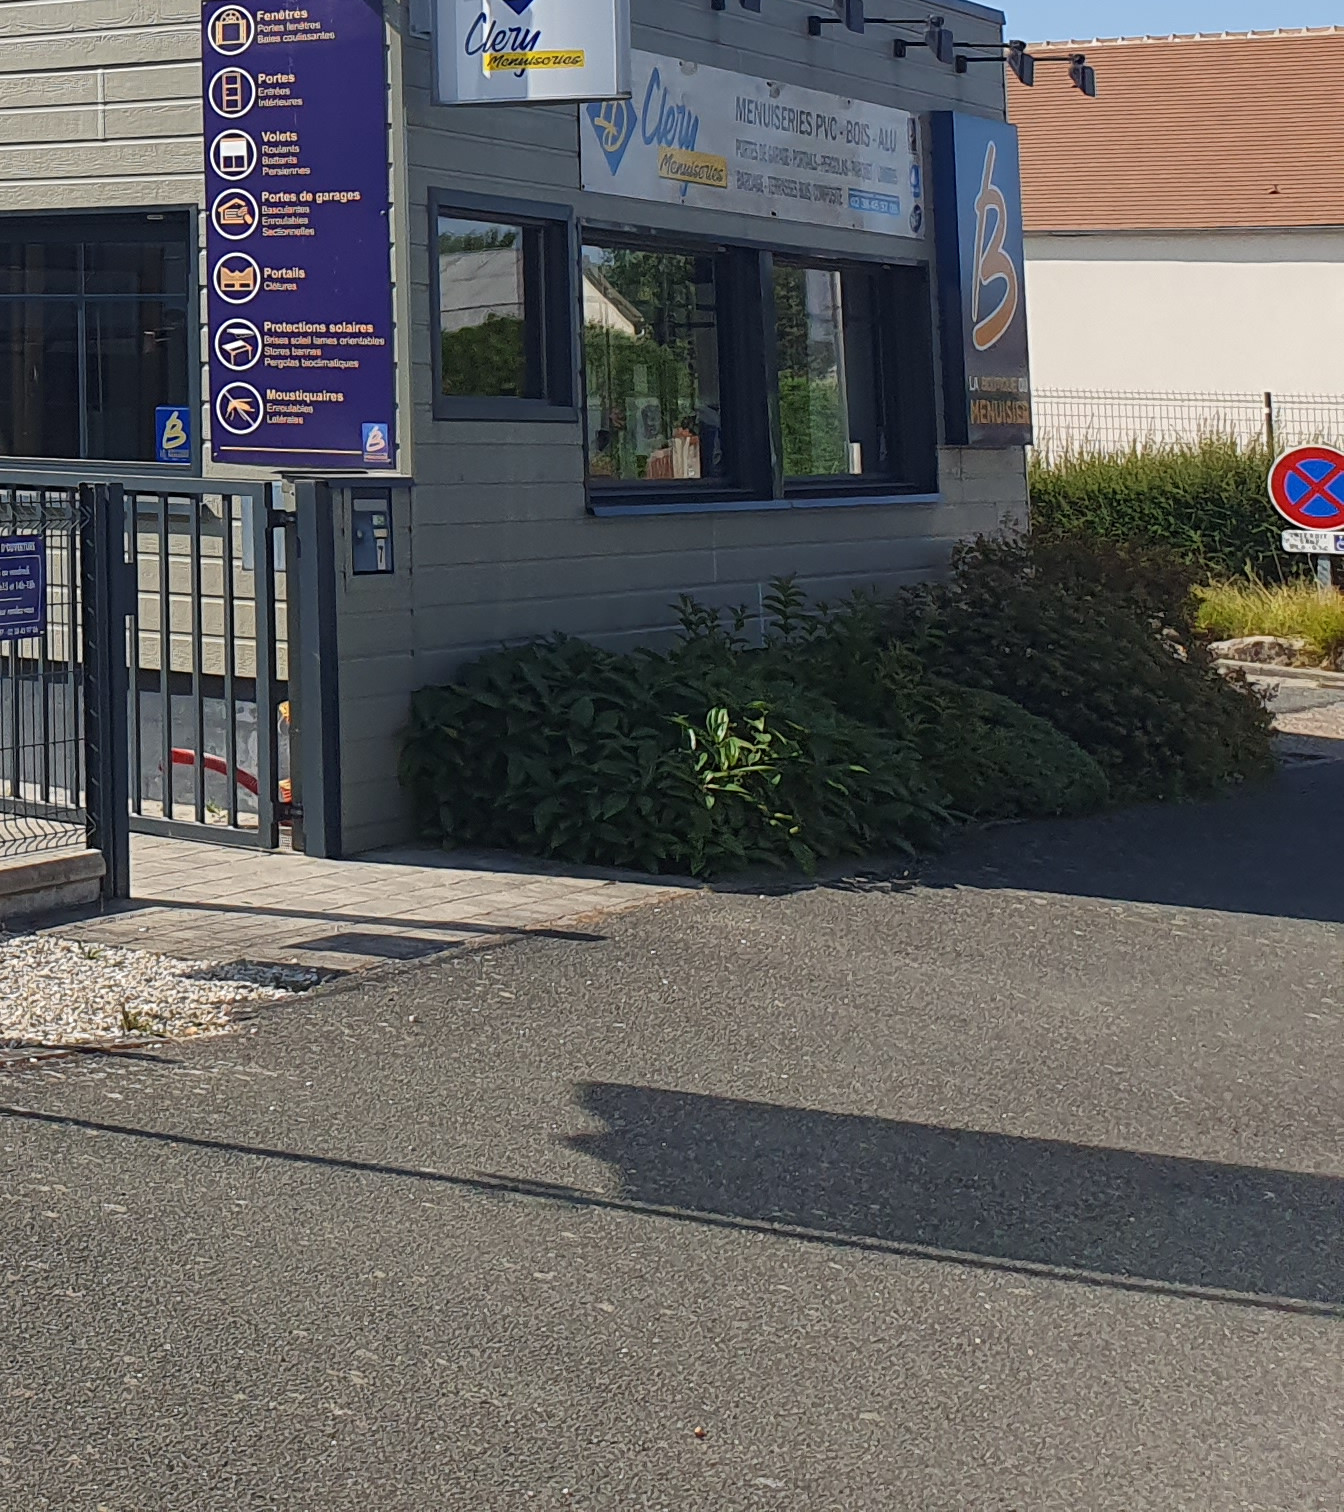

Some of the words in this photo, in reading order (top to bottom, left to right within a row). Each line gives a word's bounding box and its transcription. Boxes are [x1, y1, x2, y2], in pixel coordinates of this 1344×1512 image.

[256, 9, 308, 21] Fenêtres
[465, 11, 541, 77] Clery
[487, 54, 583, 67] Menuiseries
[258, 73, 296, 84] Portes
[735, 95, 812, 137] MENUISERIES
[815, 113, 837, 141] PVC
[846, 120, 870, 148] BOIS
[877, 128, 897, 153] ALU
[261, 131, 298, 142] Volets
[641, 66, 699, 197] Clery
[659, 153, 724, 182] Menuiseries
[261, 191, 297, 203] Portes
[299, 190, 313, 202] de
[315, 191, 361, 204] garages
[263, 267, 306, 279] Portails
[263, 321, 327, 333] Protections
[329, 322, 374, 333] solaires
[266, 389, 344, 403] Moustiquaires
[970, 399, 1030, 424] MENUISIER
